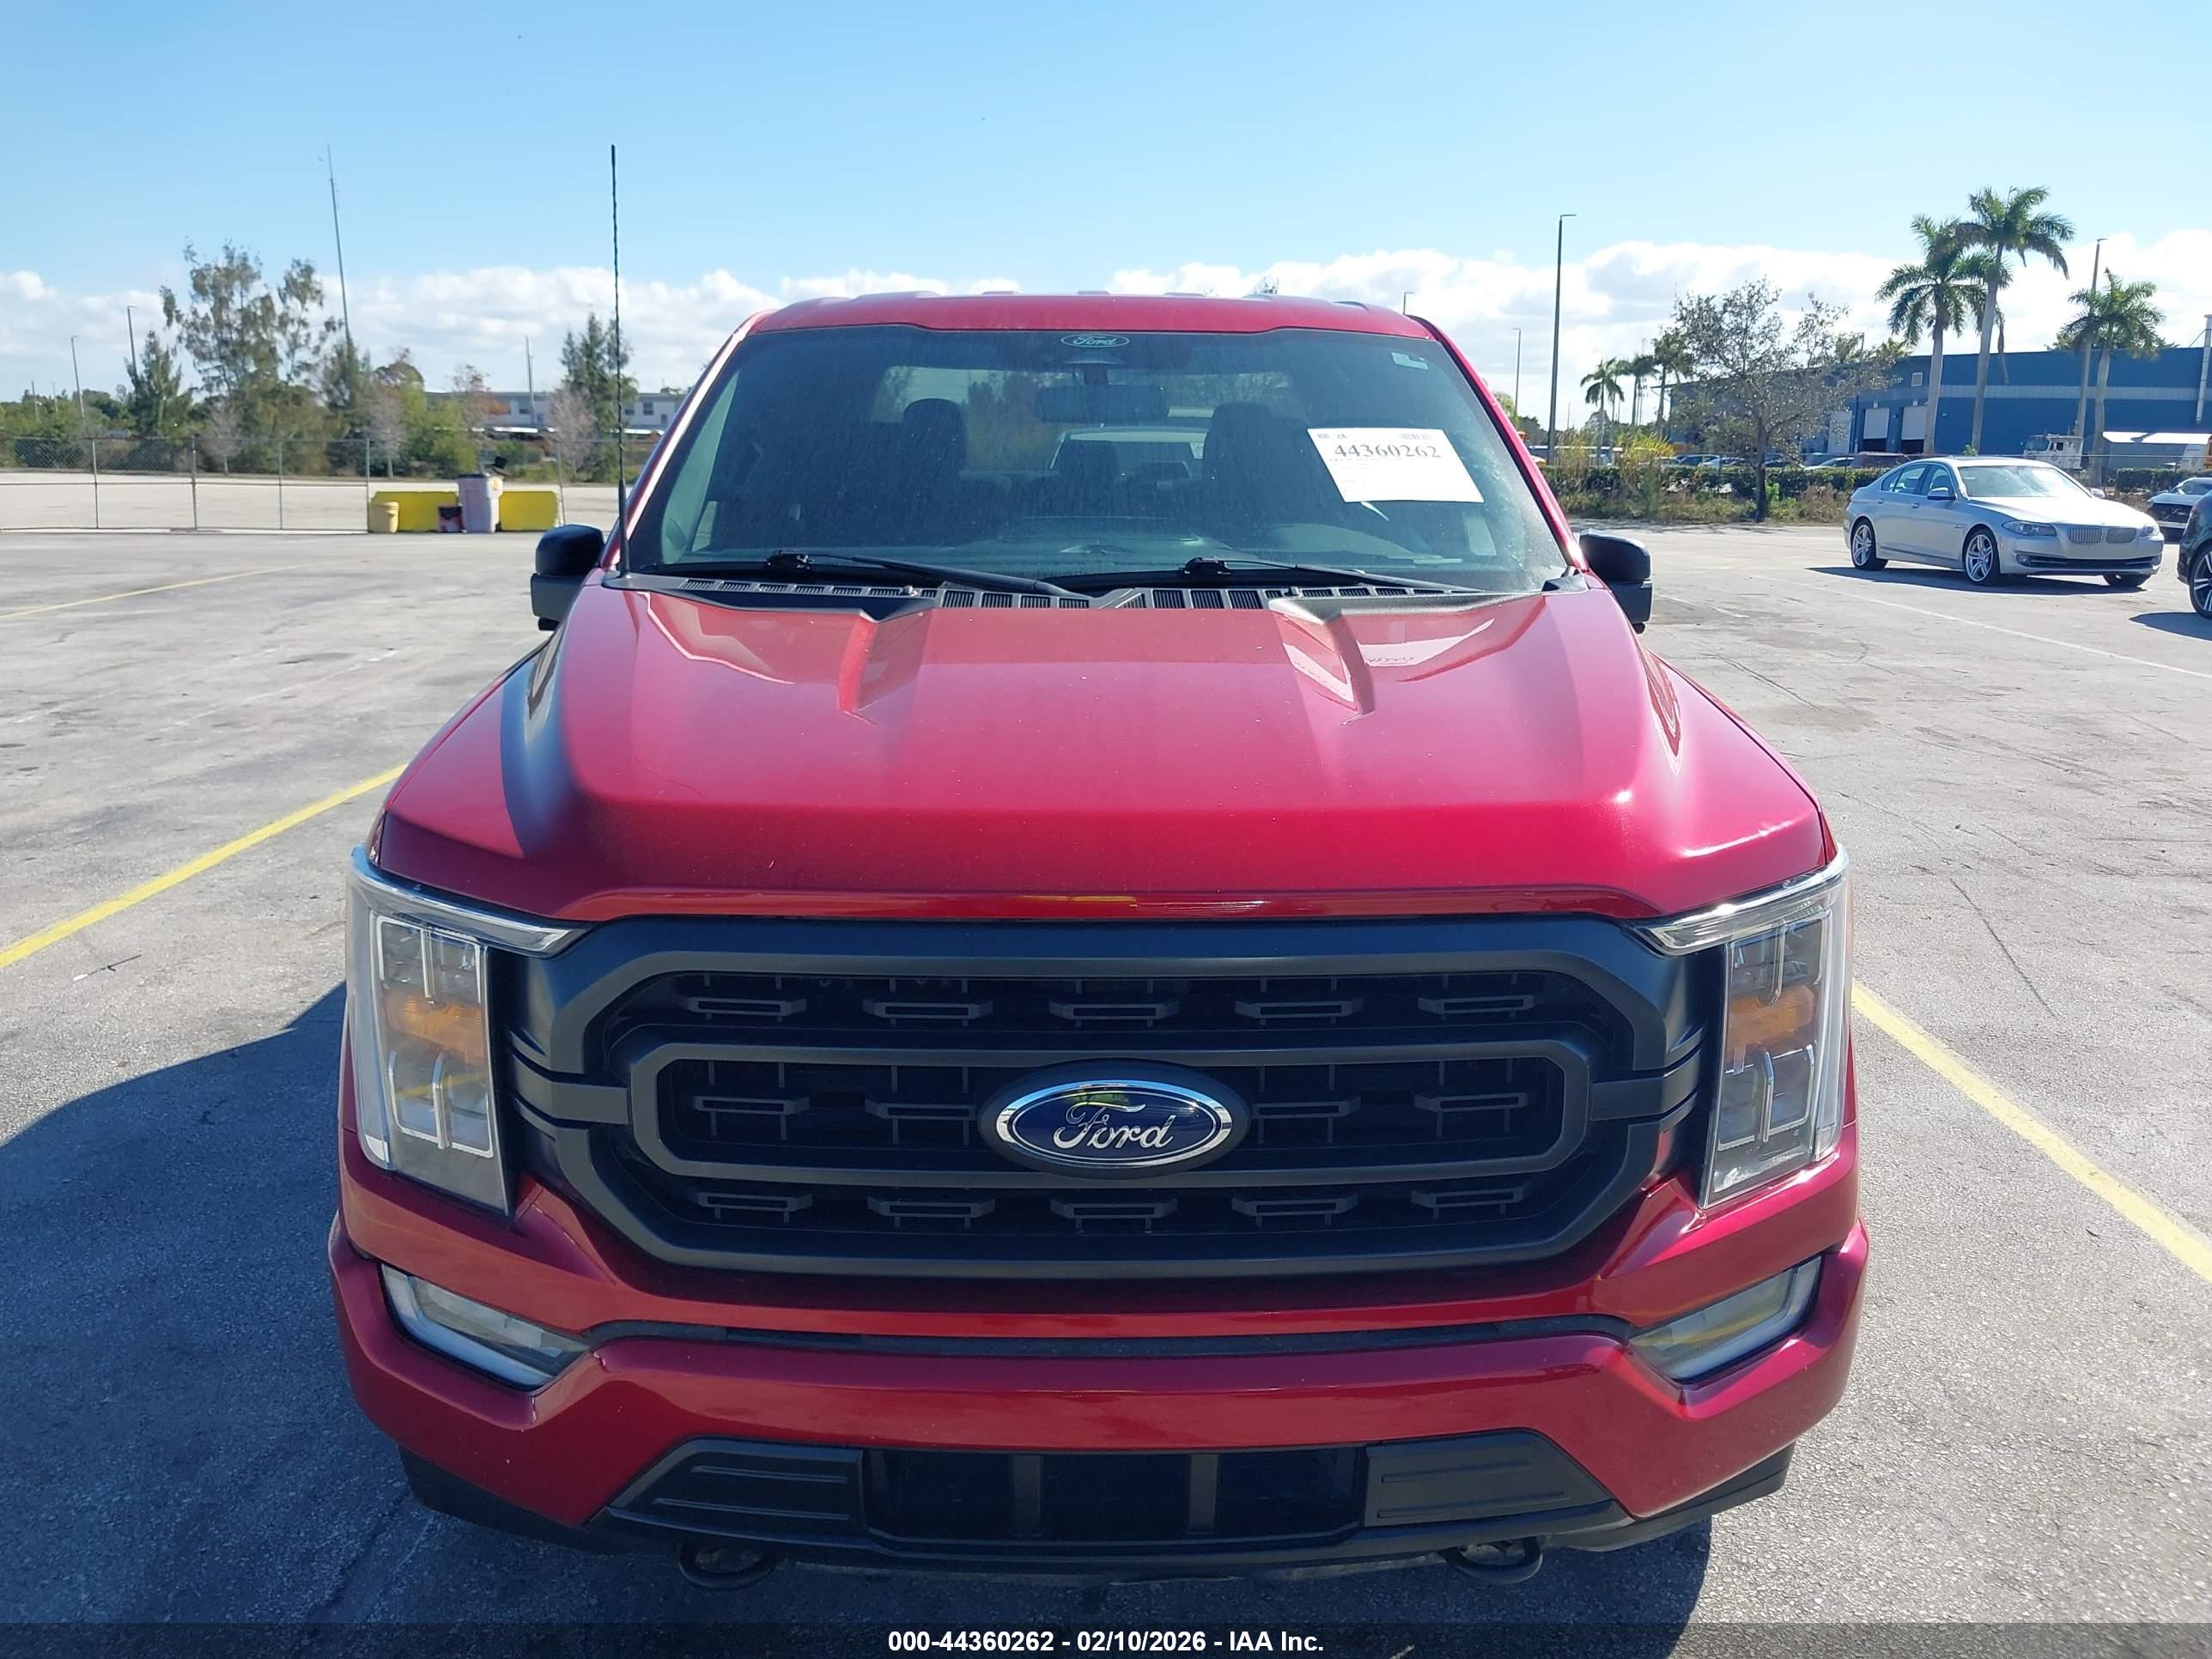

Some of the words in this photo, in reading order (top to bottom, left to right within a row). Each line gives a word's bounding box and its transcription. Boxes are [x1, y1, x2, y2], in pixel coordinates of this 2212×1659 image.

[1072, 335, 1117, 345] Ford
[1334, 443, 1442, 459] 44360262
[1053, 1101, 1177, 1150] Ford
